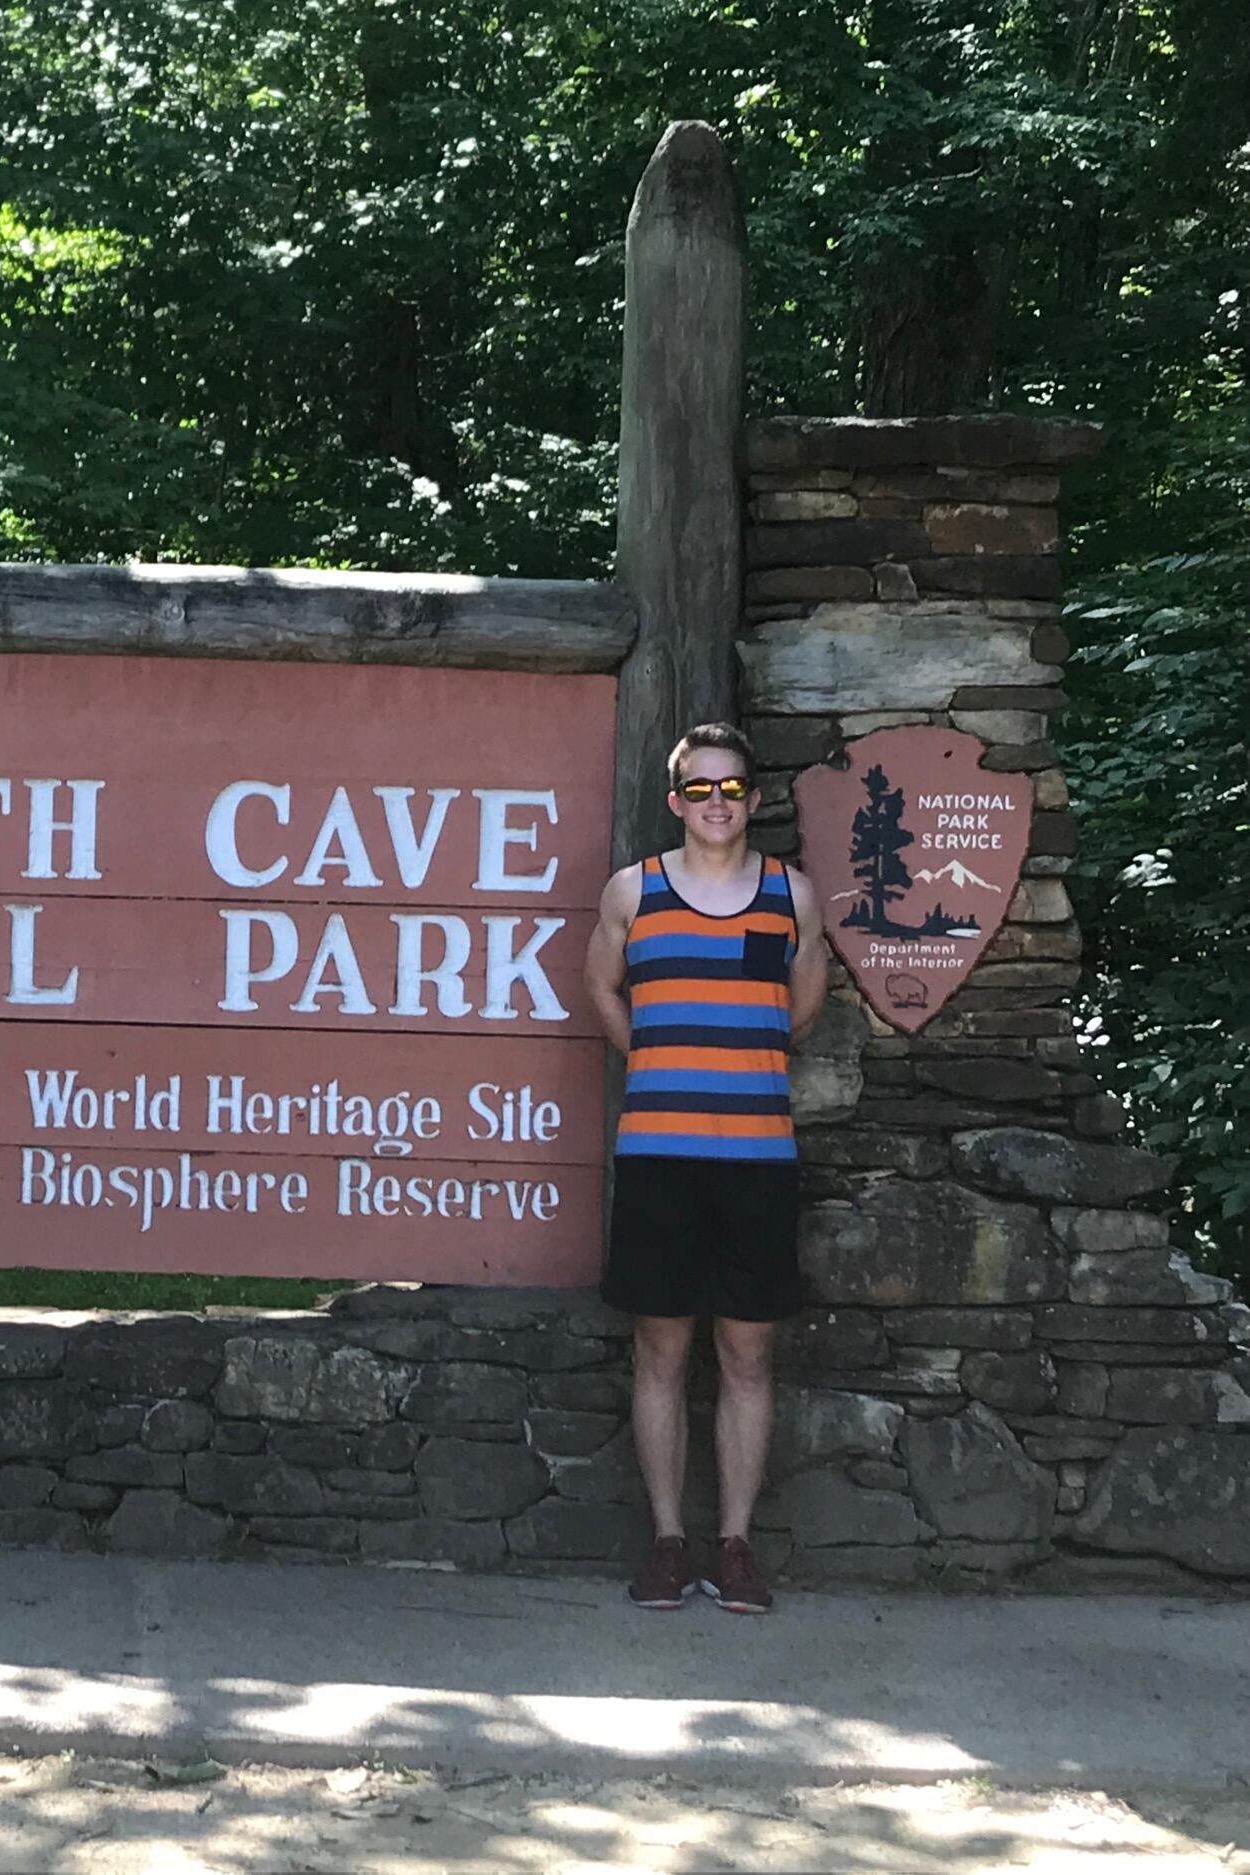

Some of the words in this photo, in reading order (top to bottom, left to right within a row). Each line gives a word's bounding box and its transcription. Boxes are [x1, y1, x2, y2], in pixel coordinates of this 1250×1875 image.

[918, 794, 1015, 810] NATIONAL
[937, 814, 989, 829] PARK
[205, 781, 559, 892] CAVE
[921, 833, 1003, 849] SERVICE
[870, 942, 956, 955] Department
[218, 909, 570, 1021] PARK
[861, 956, 876, 968] of
[880, 955, 903, 968] the
[908, 956, 965, 968] Interior
[25, 1070, 181, 1132] World
[206, 1075, 442, 1156] Heritage
[467, 1083, 561, 1142] Site
[21, 1148, 308, 1232] Biosphere
[337, 1158, 560, 1221] Reserve
